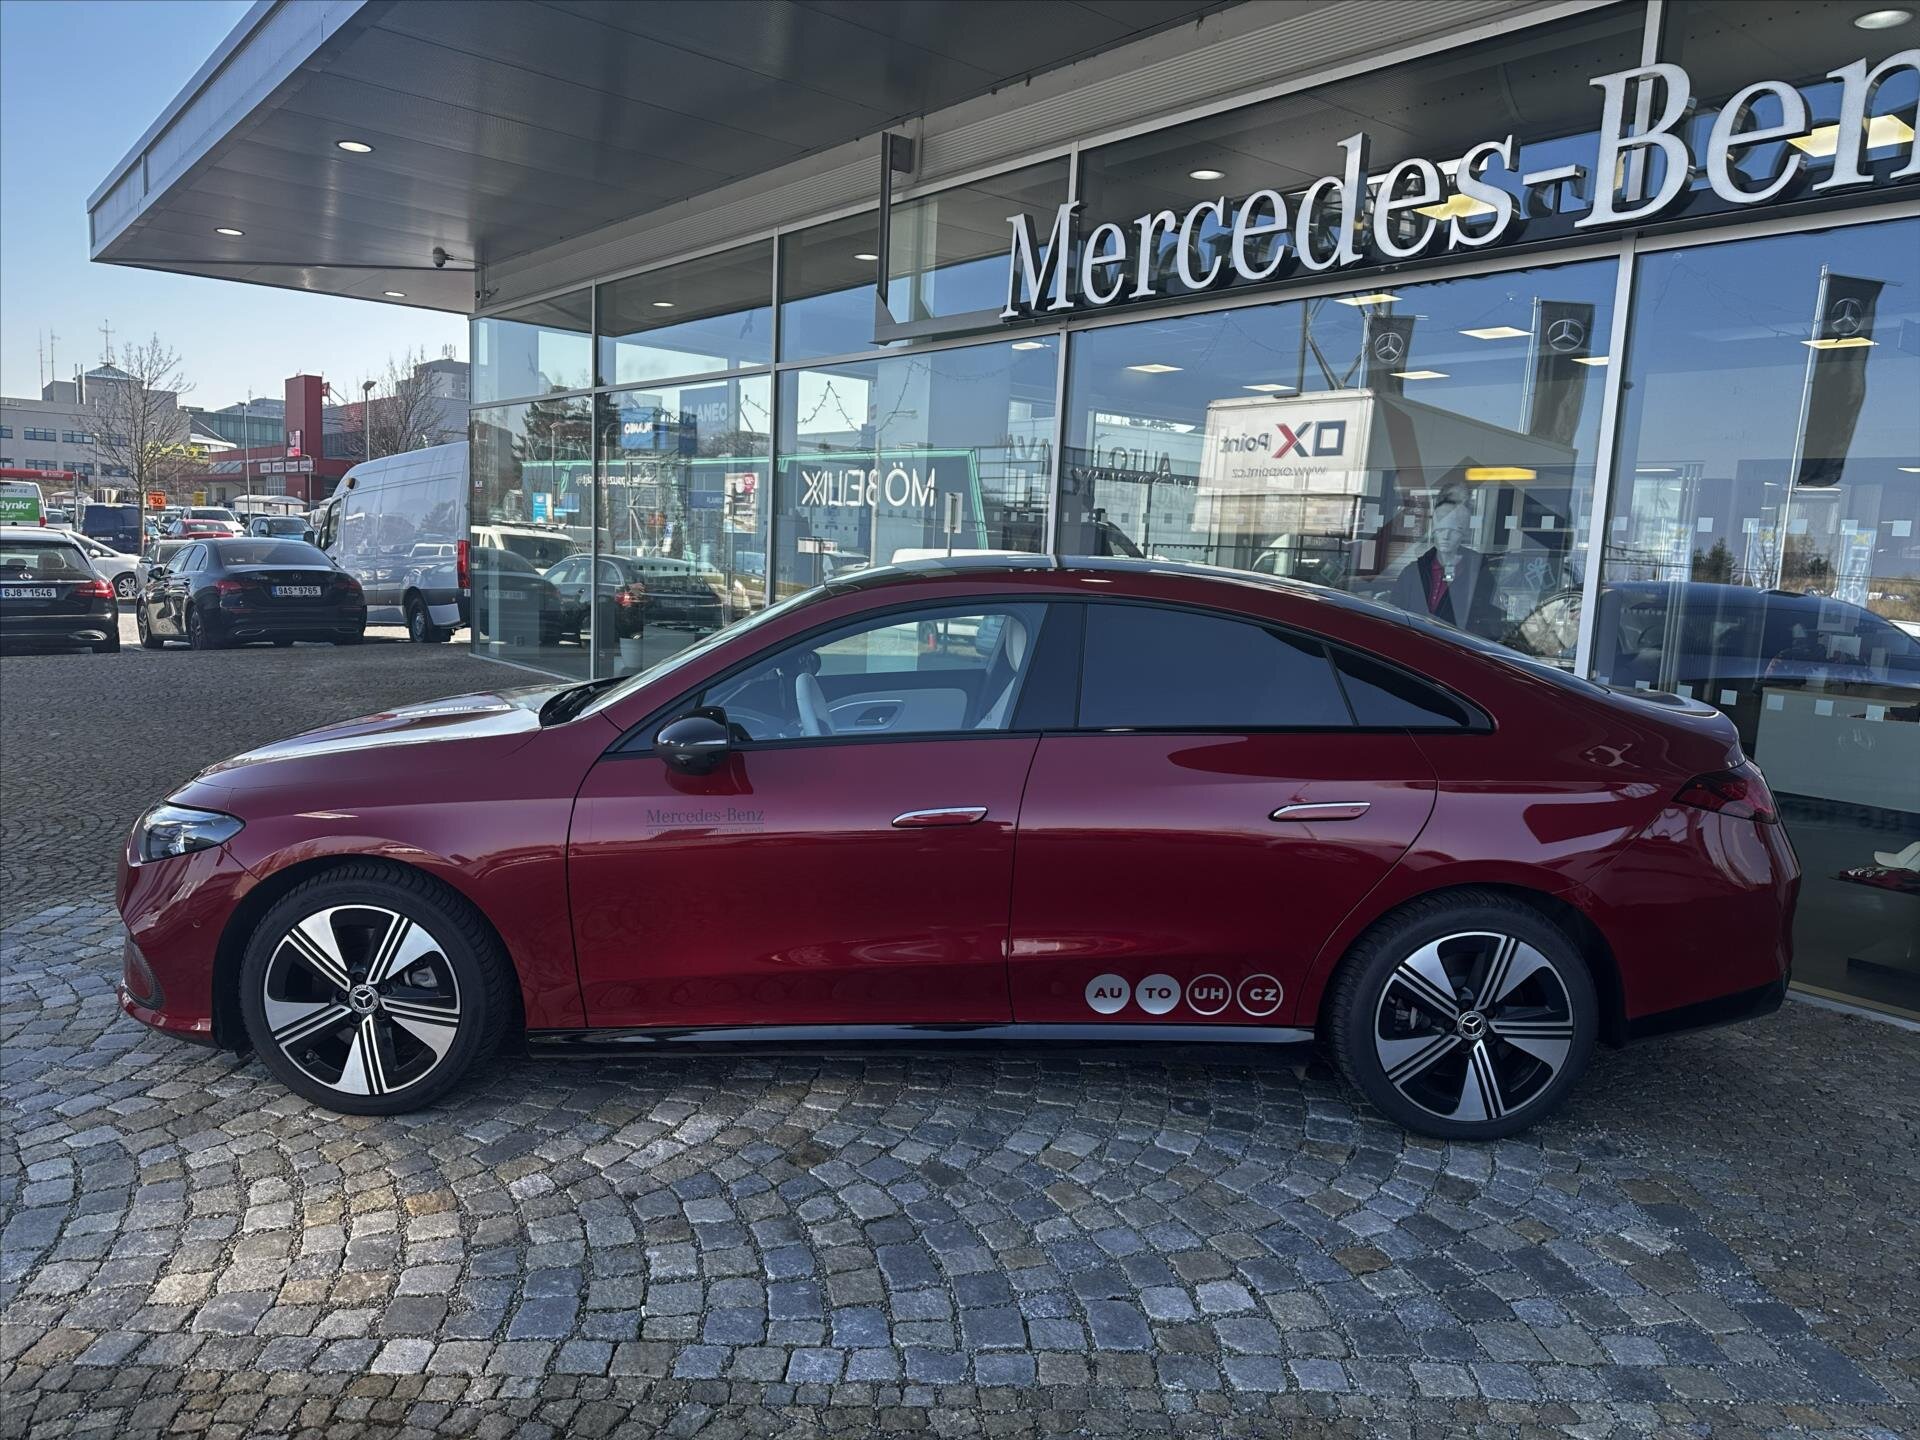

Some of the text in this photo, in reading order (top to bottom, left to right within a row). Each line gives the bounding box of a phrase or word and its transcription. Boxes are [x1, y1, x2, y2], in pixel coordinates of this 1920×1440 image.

[4, 588, 53, 598] 6J8 1546
[646, 807, 764, 824] Mercedes-Benz
[1094, 987, 1277, 1001] AU TO UH CZ
